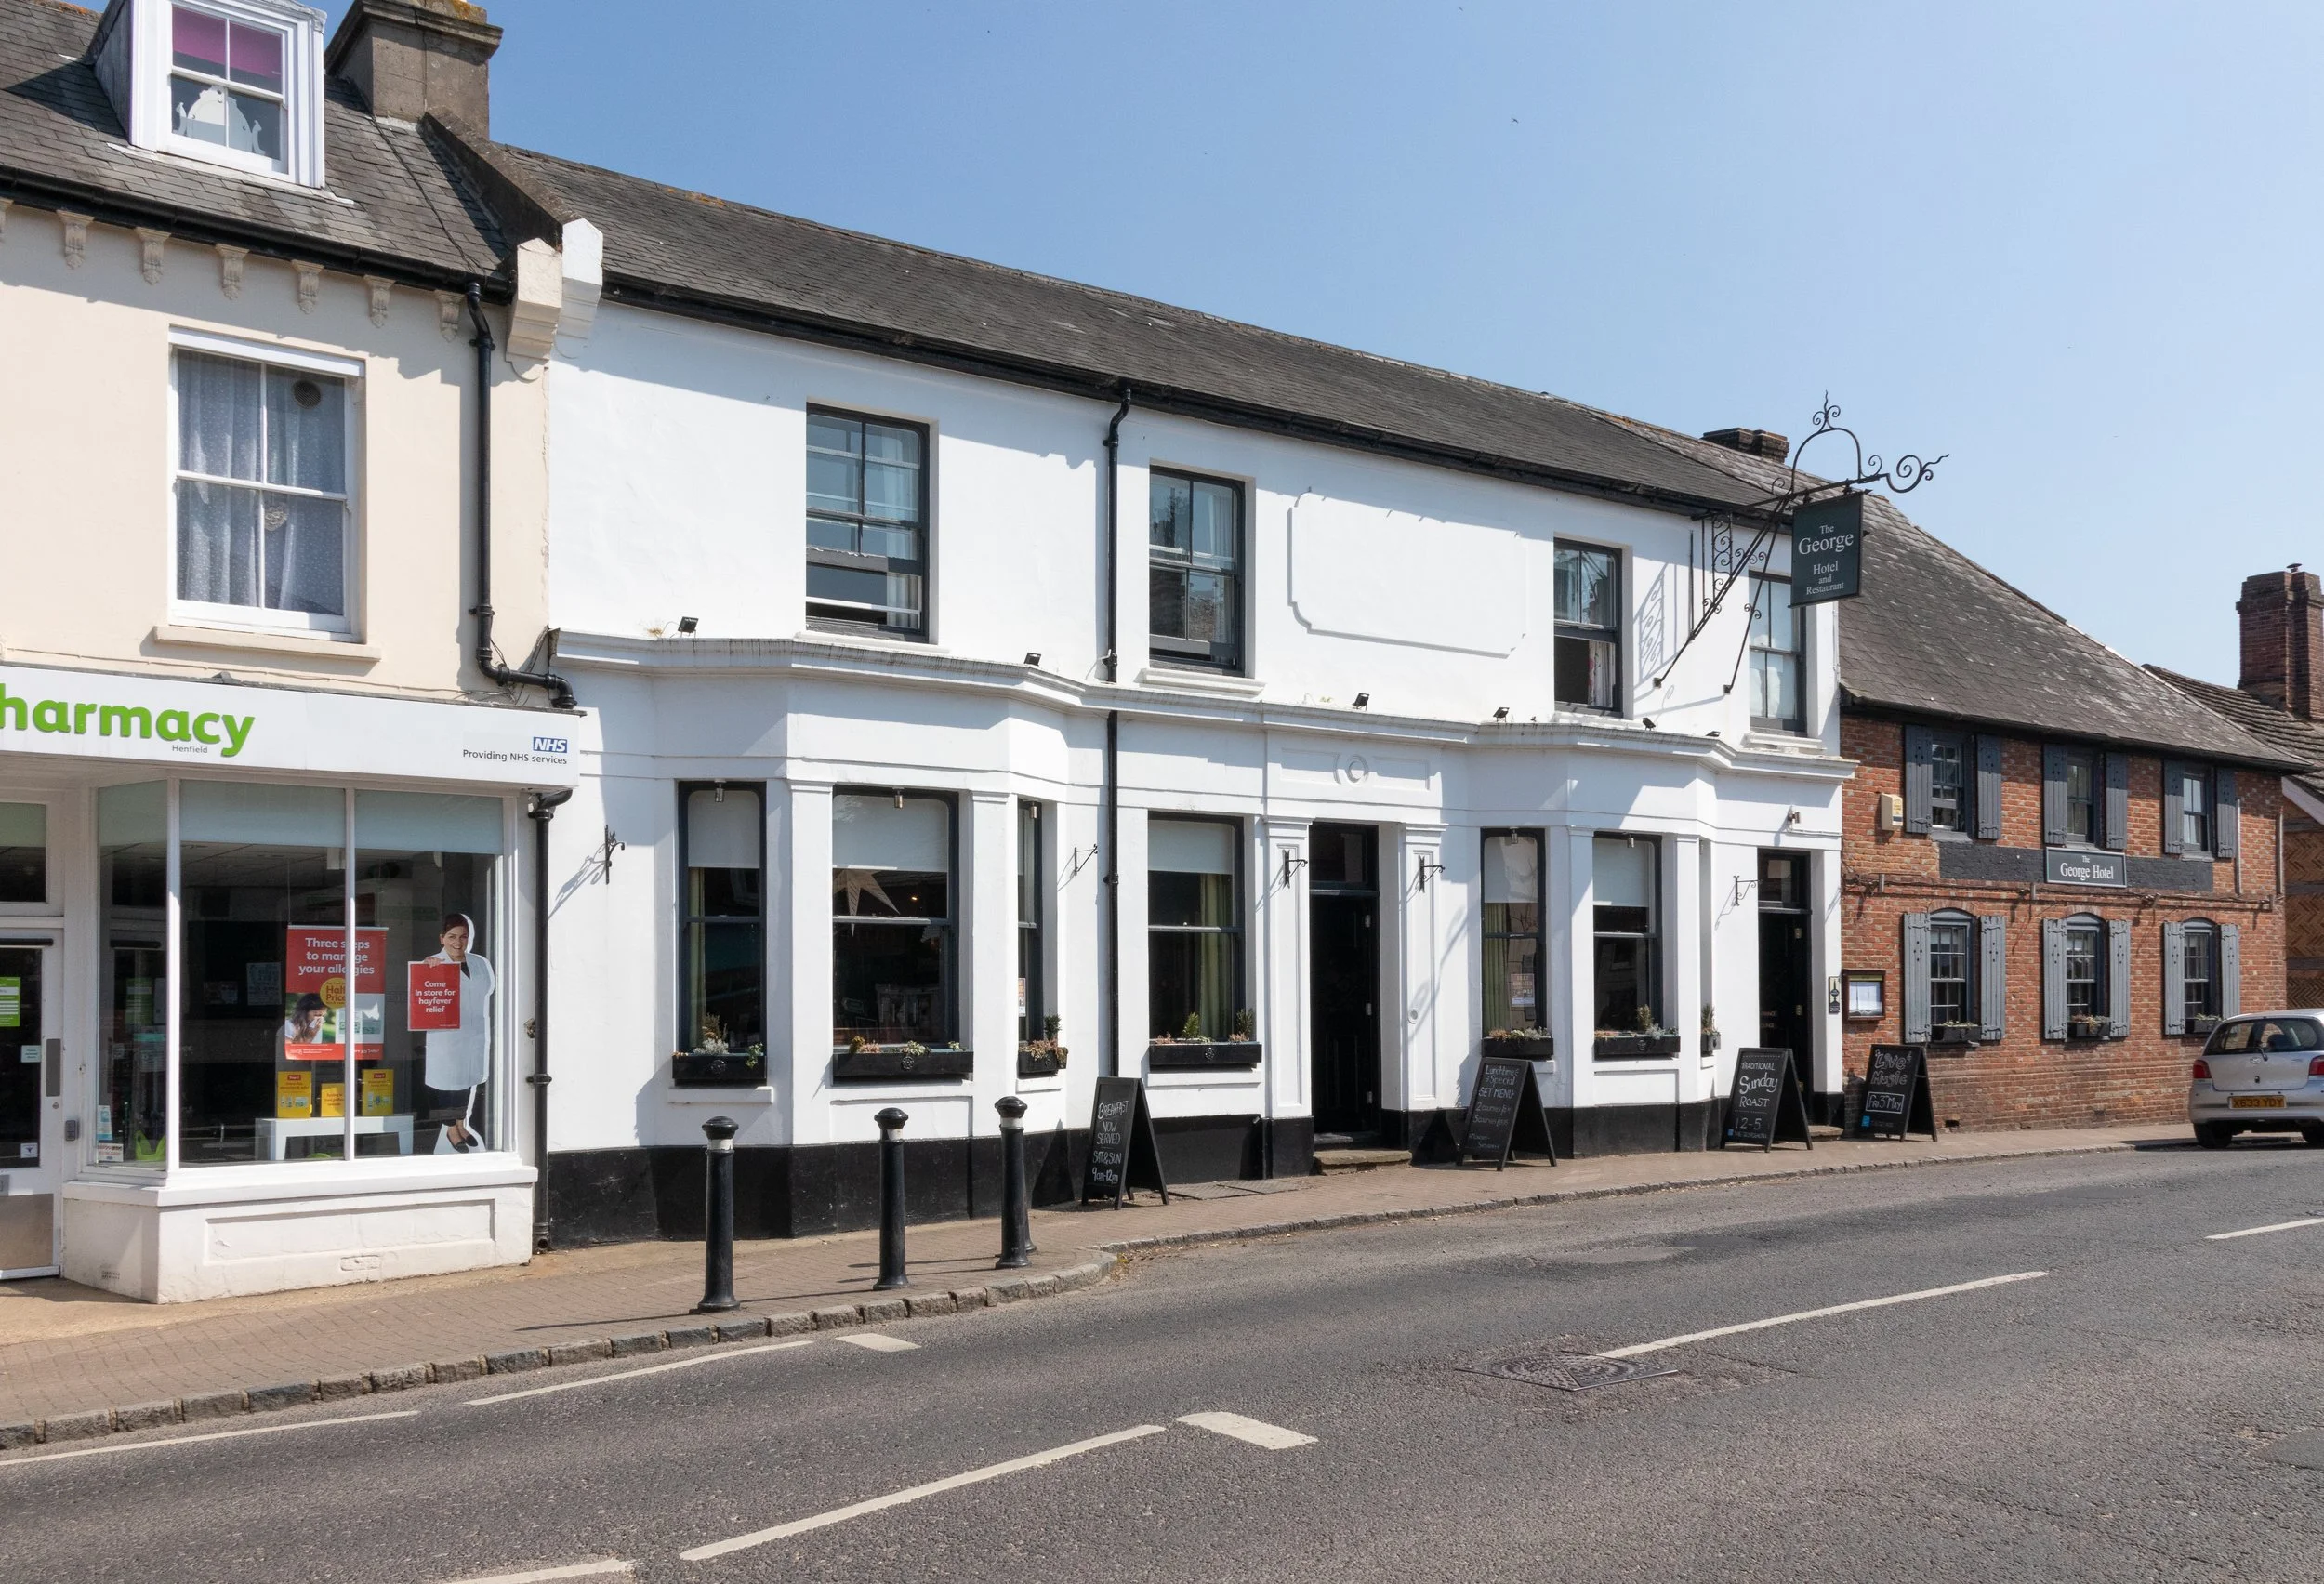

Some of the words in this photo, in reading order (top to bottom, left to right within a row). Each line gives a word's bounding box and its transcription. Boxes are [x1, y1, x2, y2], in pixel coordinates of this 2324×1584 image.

[1819, 524, 1835, 535] The
[1798, 533, 1854, 555] George
[1813, 561, 1839, 575] Hotel
[1818, 574, 1832, 584] and
[1806, 582, 1844, 595] Restaurant
[172, 745, 208, 754] Henfield
[533, 737, 567, 753] NHS
[463, 749, 508, 762] Providing
[509, 753, 529, 762] NHS
[531, 756, 567, 764] services
[2082, 855, 2091, 864] The
[2060, 862, 2091, 881] George
[2093, 865, 2114, 879] Hotel
[305, 937, 338, 948] Three
[340, 940, 370, 952] sps
[306, 951, 319, 960] to
[322, 953, 368, 964] mage
[298, 966, 325, 976] your
[327, 963, 375, 977] allegies
[444, 988, 456, 997] for
[418, 997, 453, 1006] hayfever
[425, 1005, 446, 1013] relief
[1741, 1062, 1776, 1071] TRADITIONAL
[1489, 1075, 1516, 1088] Special
[1739, 1072, 1777, 1095] Sunday
[1478, 1087, 1494, 1097] SET
[1494, 1089, 1514, 1099] MENU
[1739, 1096, 1770, 1108] ROAST
[1098, 1100, 1129, 1119] BREAKFAST
[1102, 1121, 1117, 1132] NOW
[1097, 1134, 1121, 1145] SERVED
